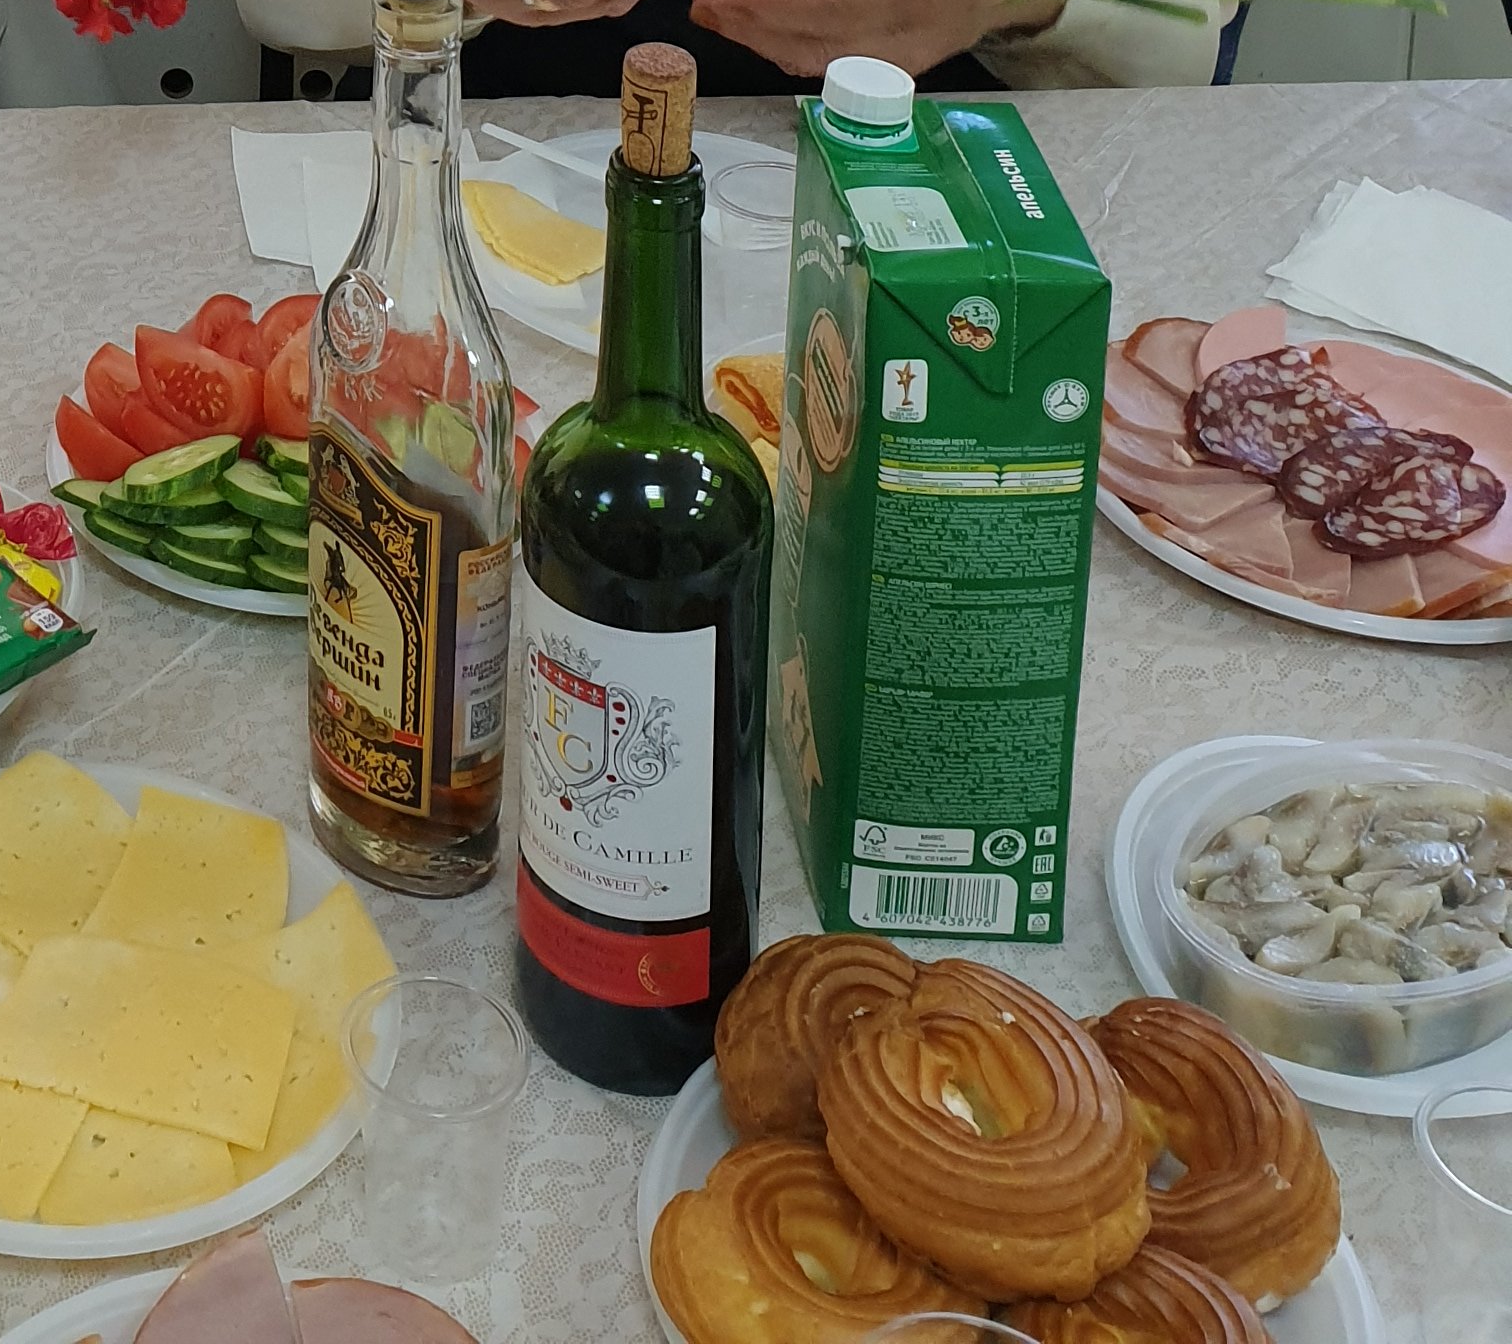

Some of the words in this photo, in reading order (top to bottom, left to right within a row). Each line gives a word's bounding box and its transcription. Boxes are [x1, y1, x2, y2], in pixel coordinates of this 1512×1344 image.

[993, 149, 1045, 219] апельсин
[544, 685, 574, 732] F
[556, 732, 593, 774] C
[543, 813, 566, 841] DE
[572, 830, 693, 865] CAMILLE
[564, 861, 639, 893] SEMI-SWEET
[862, 912, 871, 922] 4
[880, 914, 932, 926] 607042
[939, 916, 992, 928] 438776
